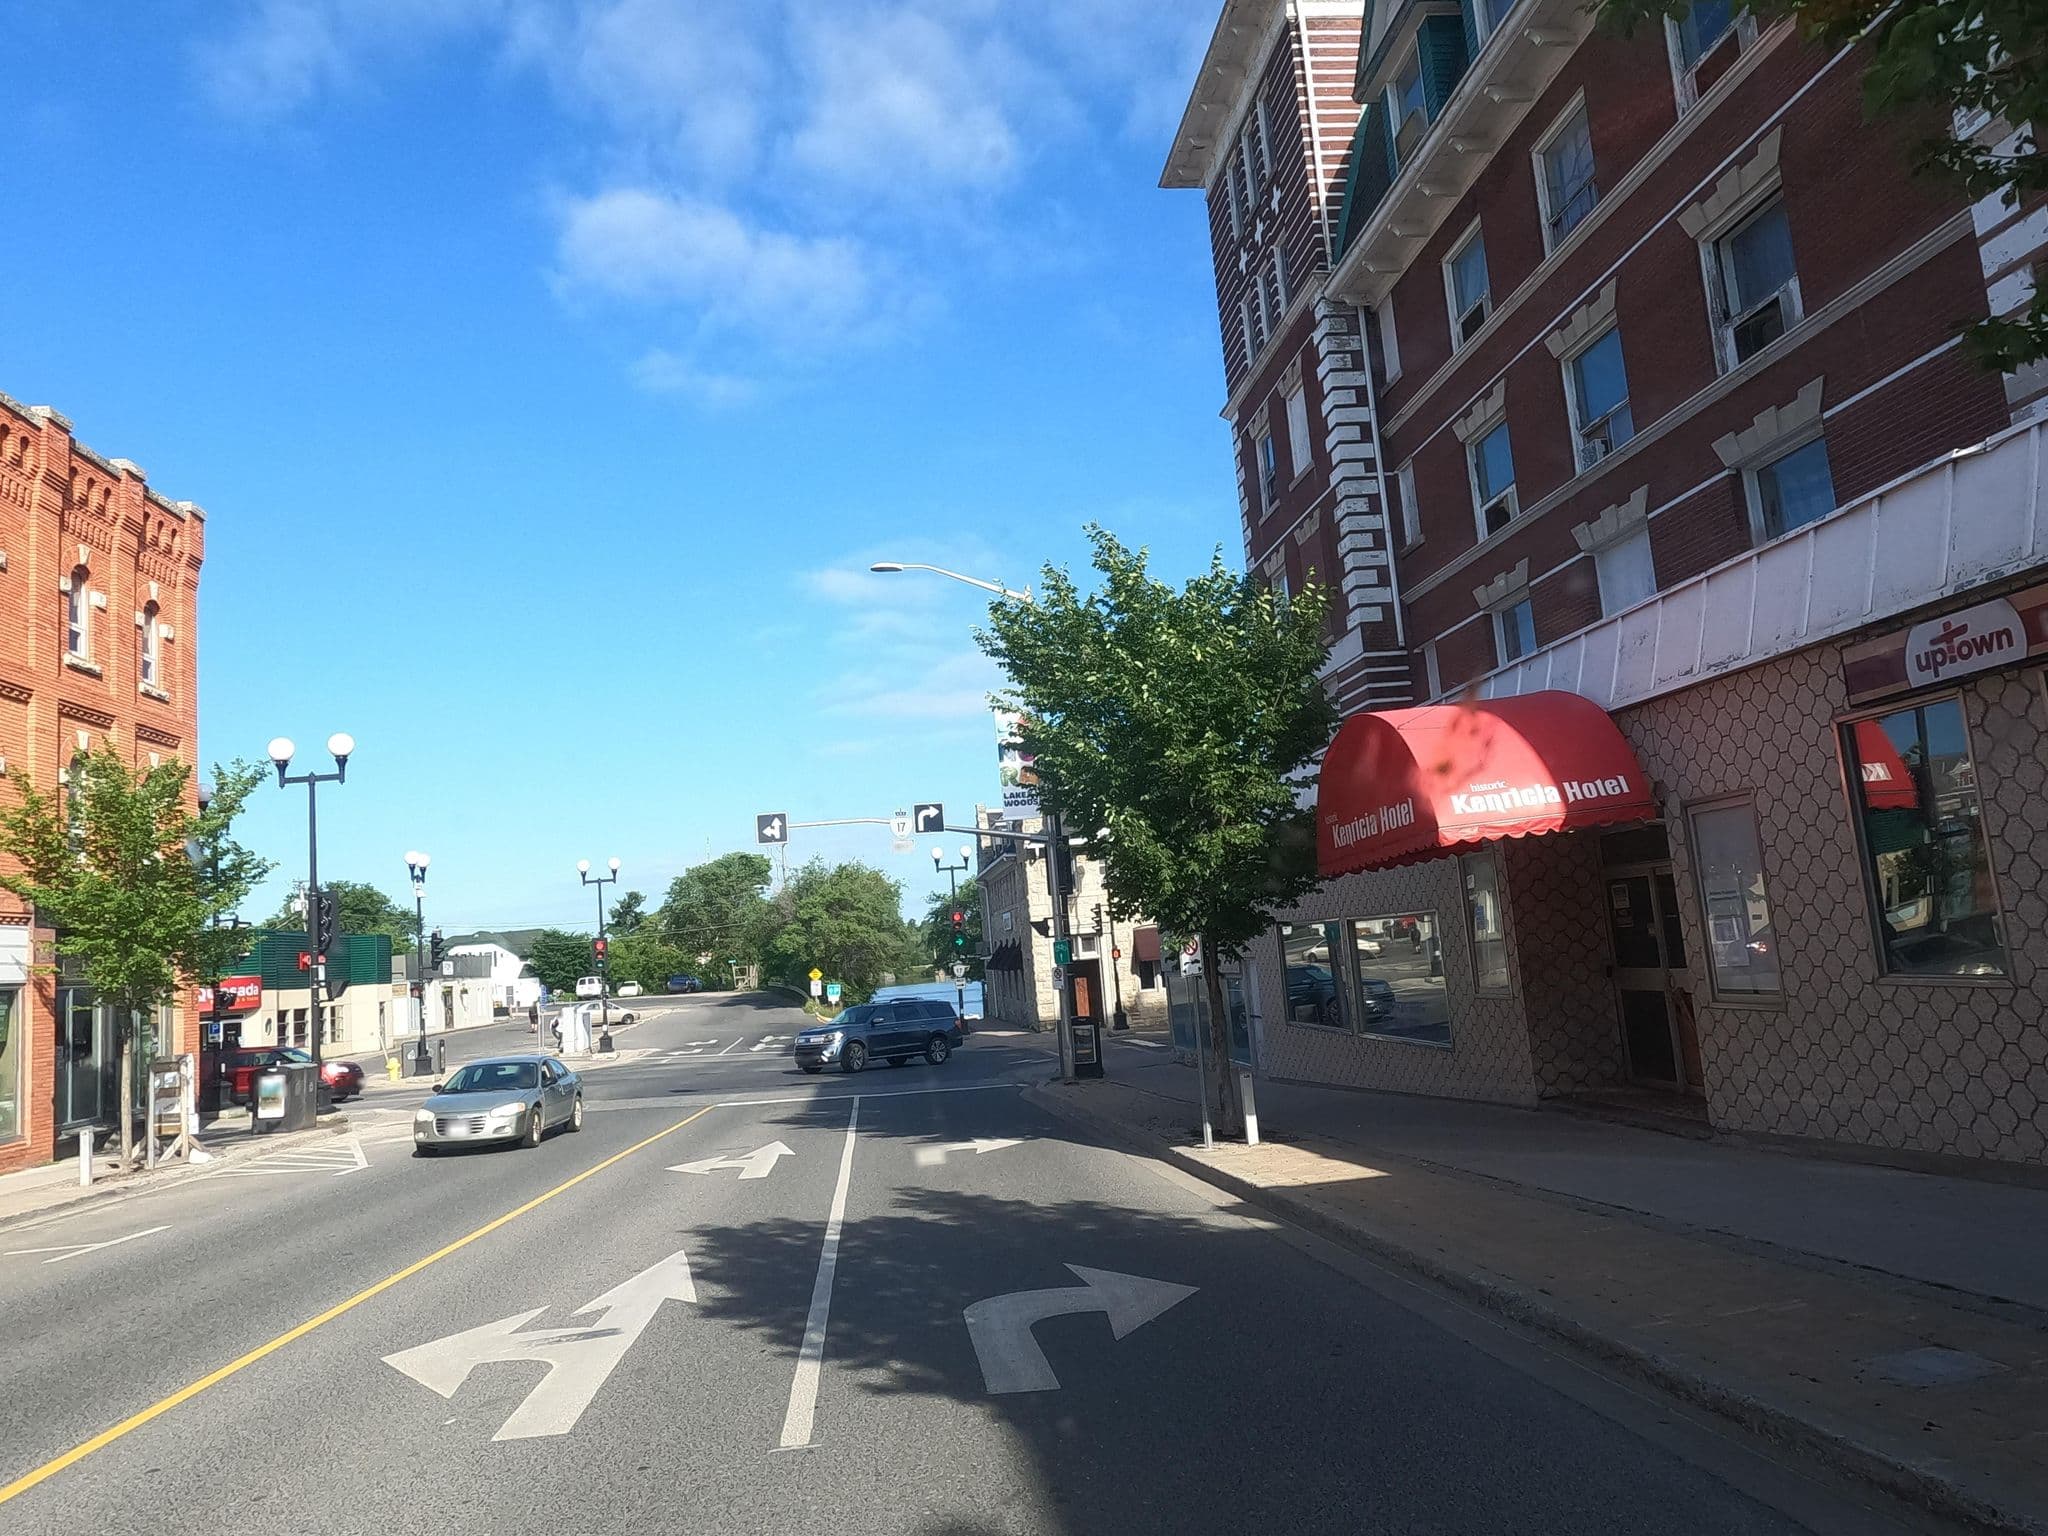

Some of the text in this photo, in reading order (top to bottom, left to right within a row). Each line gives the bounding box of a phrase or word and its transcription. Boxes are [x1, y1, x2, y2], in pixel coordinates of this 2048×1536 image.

[1915, 621, 2014, 678] uptown
[1470, 780, 1508, 793] historic
[1562, 775, 1631, 803] Hotel
[1004, 799, 1039, 808] WOODS
[897, 822, 906, 832] 17
[1332, 797, 1415, 849] Kenricia Hotel
